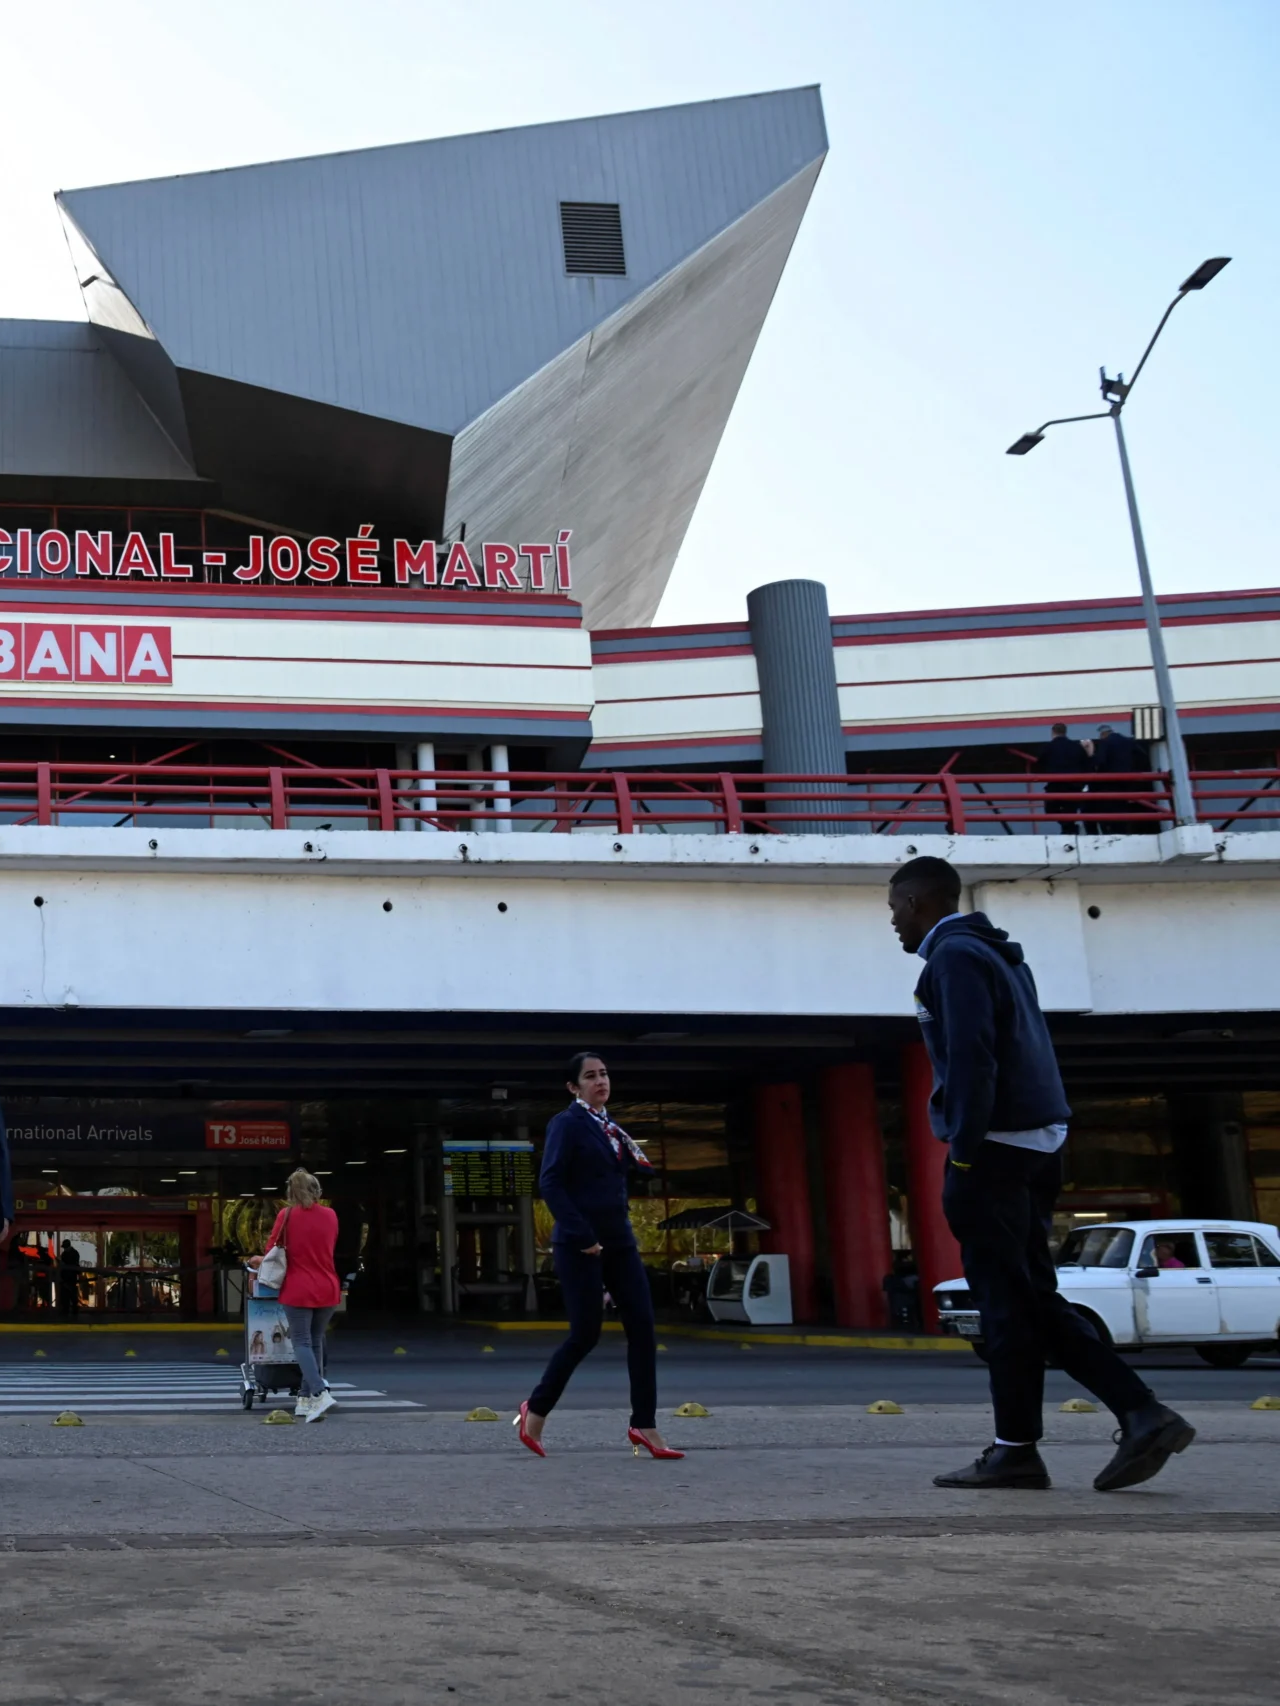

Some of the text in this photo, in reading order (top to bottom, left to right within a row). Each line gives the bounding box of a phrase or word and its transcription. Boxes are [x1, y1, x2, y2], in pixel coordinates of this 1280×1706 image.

[233, 524, 382, 584] JOSÉ
[394, 529, 573, 590] MARTÍ
[86, 1124, 153, 1141] Arrivals
[209, 1124, 237, 1145] T3
